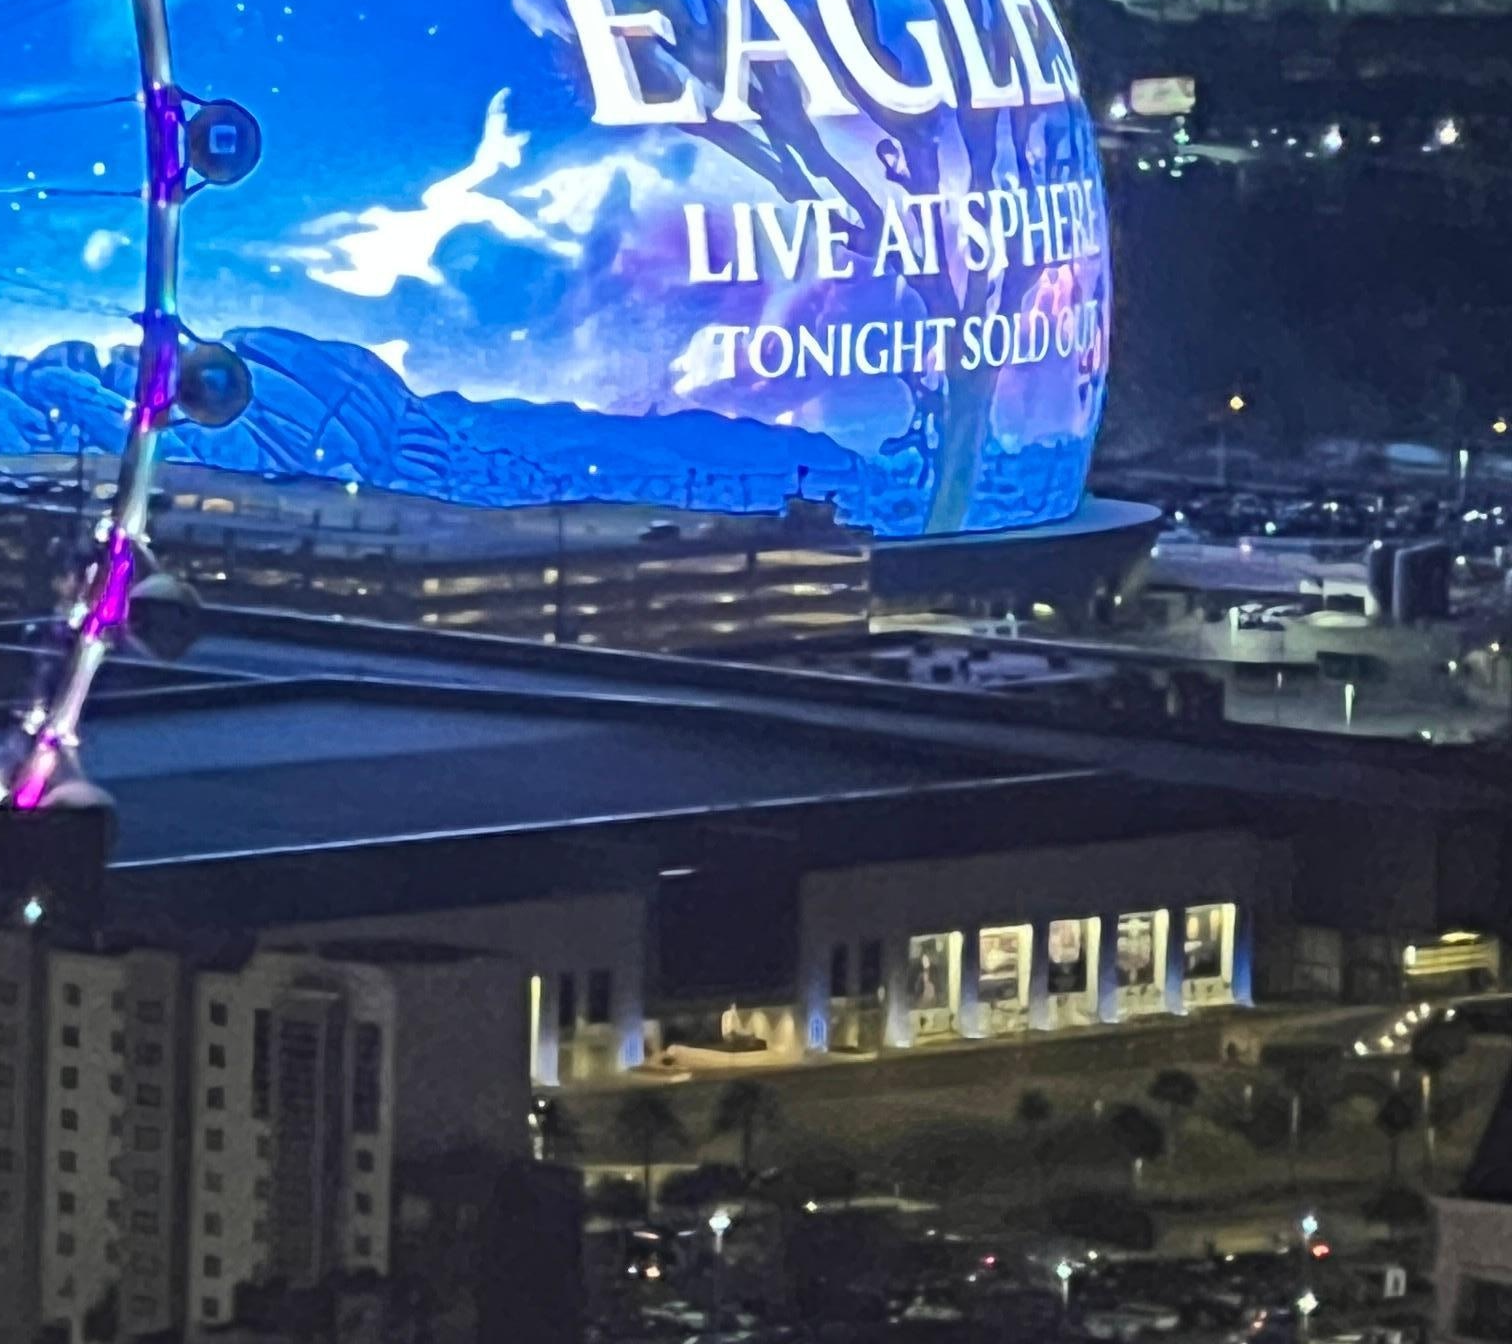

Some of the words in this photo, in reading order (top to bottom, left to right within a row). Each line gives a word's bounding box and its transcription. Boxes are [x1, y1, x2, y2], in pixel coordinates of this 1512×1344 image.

[683, 200, 855, 285] LIVE
[873, 193, 947, 278] AT
[959, 179, 1101, 273] SPHERE
[709, 317, 956, 380] TONIGHT
[961, 311, 1050, 371] SOLD
[1055, 300, 1098, 358] OUT
